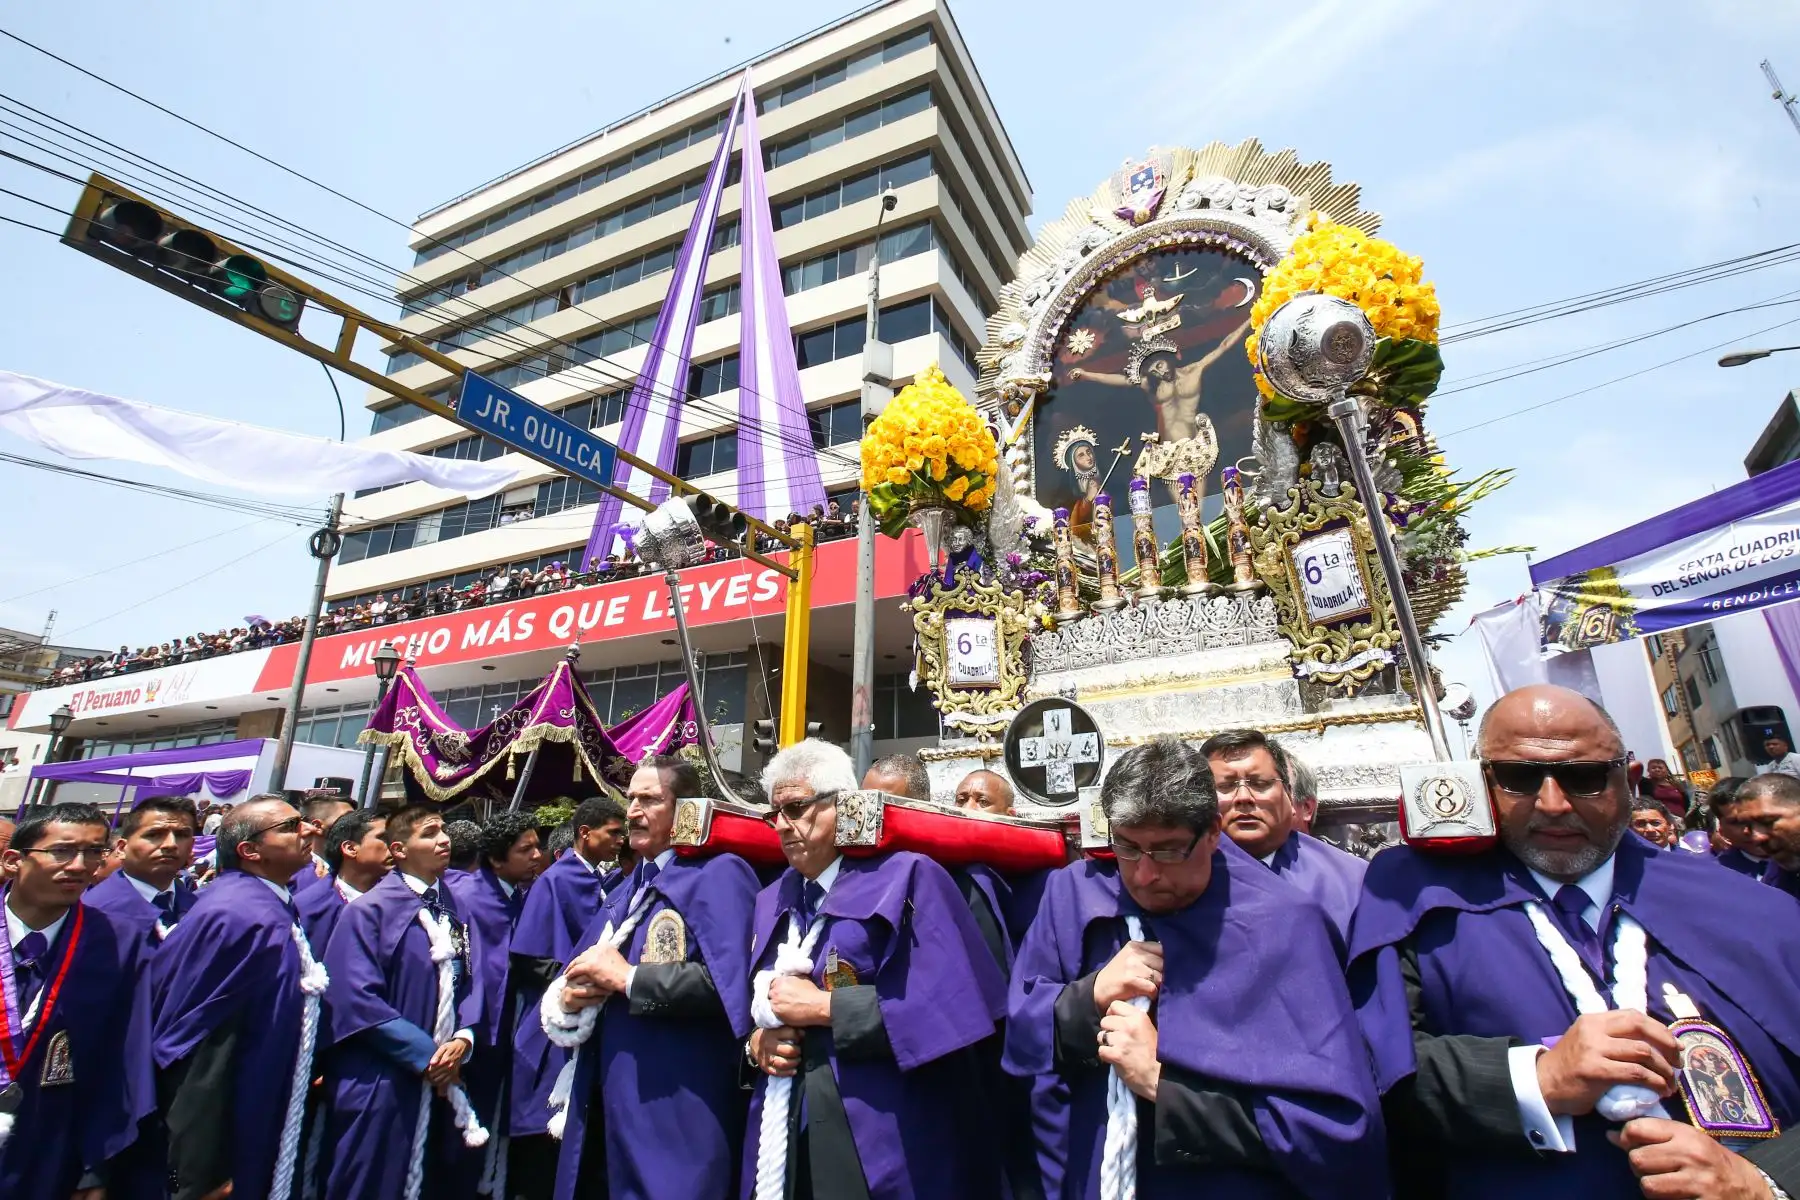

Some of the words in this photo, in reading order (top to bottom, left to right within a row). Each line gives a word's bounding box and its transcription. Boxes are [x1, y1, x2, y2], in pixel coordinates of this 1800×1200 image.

[476, 394, 515, 432] JR.
[523, 415, 602, 475] QUILCA
[1651, 580, 1680, 597] DEL
[1761, 545, 1794, 564] LOS
[1311, 585, 1354, 609] CUADRILLA
[340, 627, 450, 669] MUCHO
[461, 609, 536, 649] MÁS
[549, 595, 630, 639] QUE
[642, 568, 780, 621] LEYES
[1585, 613, 1605, 637] 6
[958, 661, 992, 677] CUADRILLA
[69, 691, 85, 713] El
[83, 687, 141, 712] Peruano
[1434, 779, 1457, 813] 8
[1725, 1102, 1739, 1119] 6
